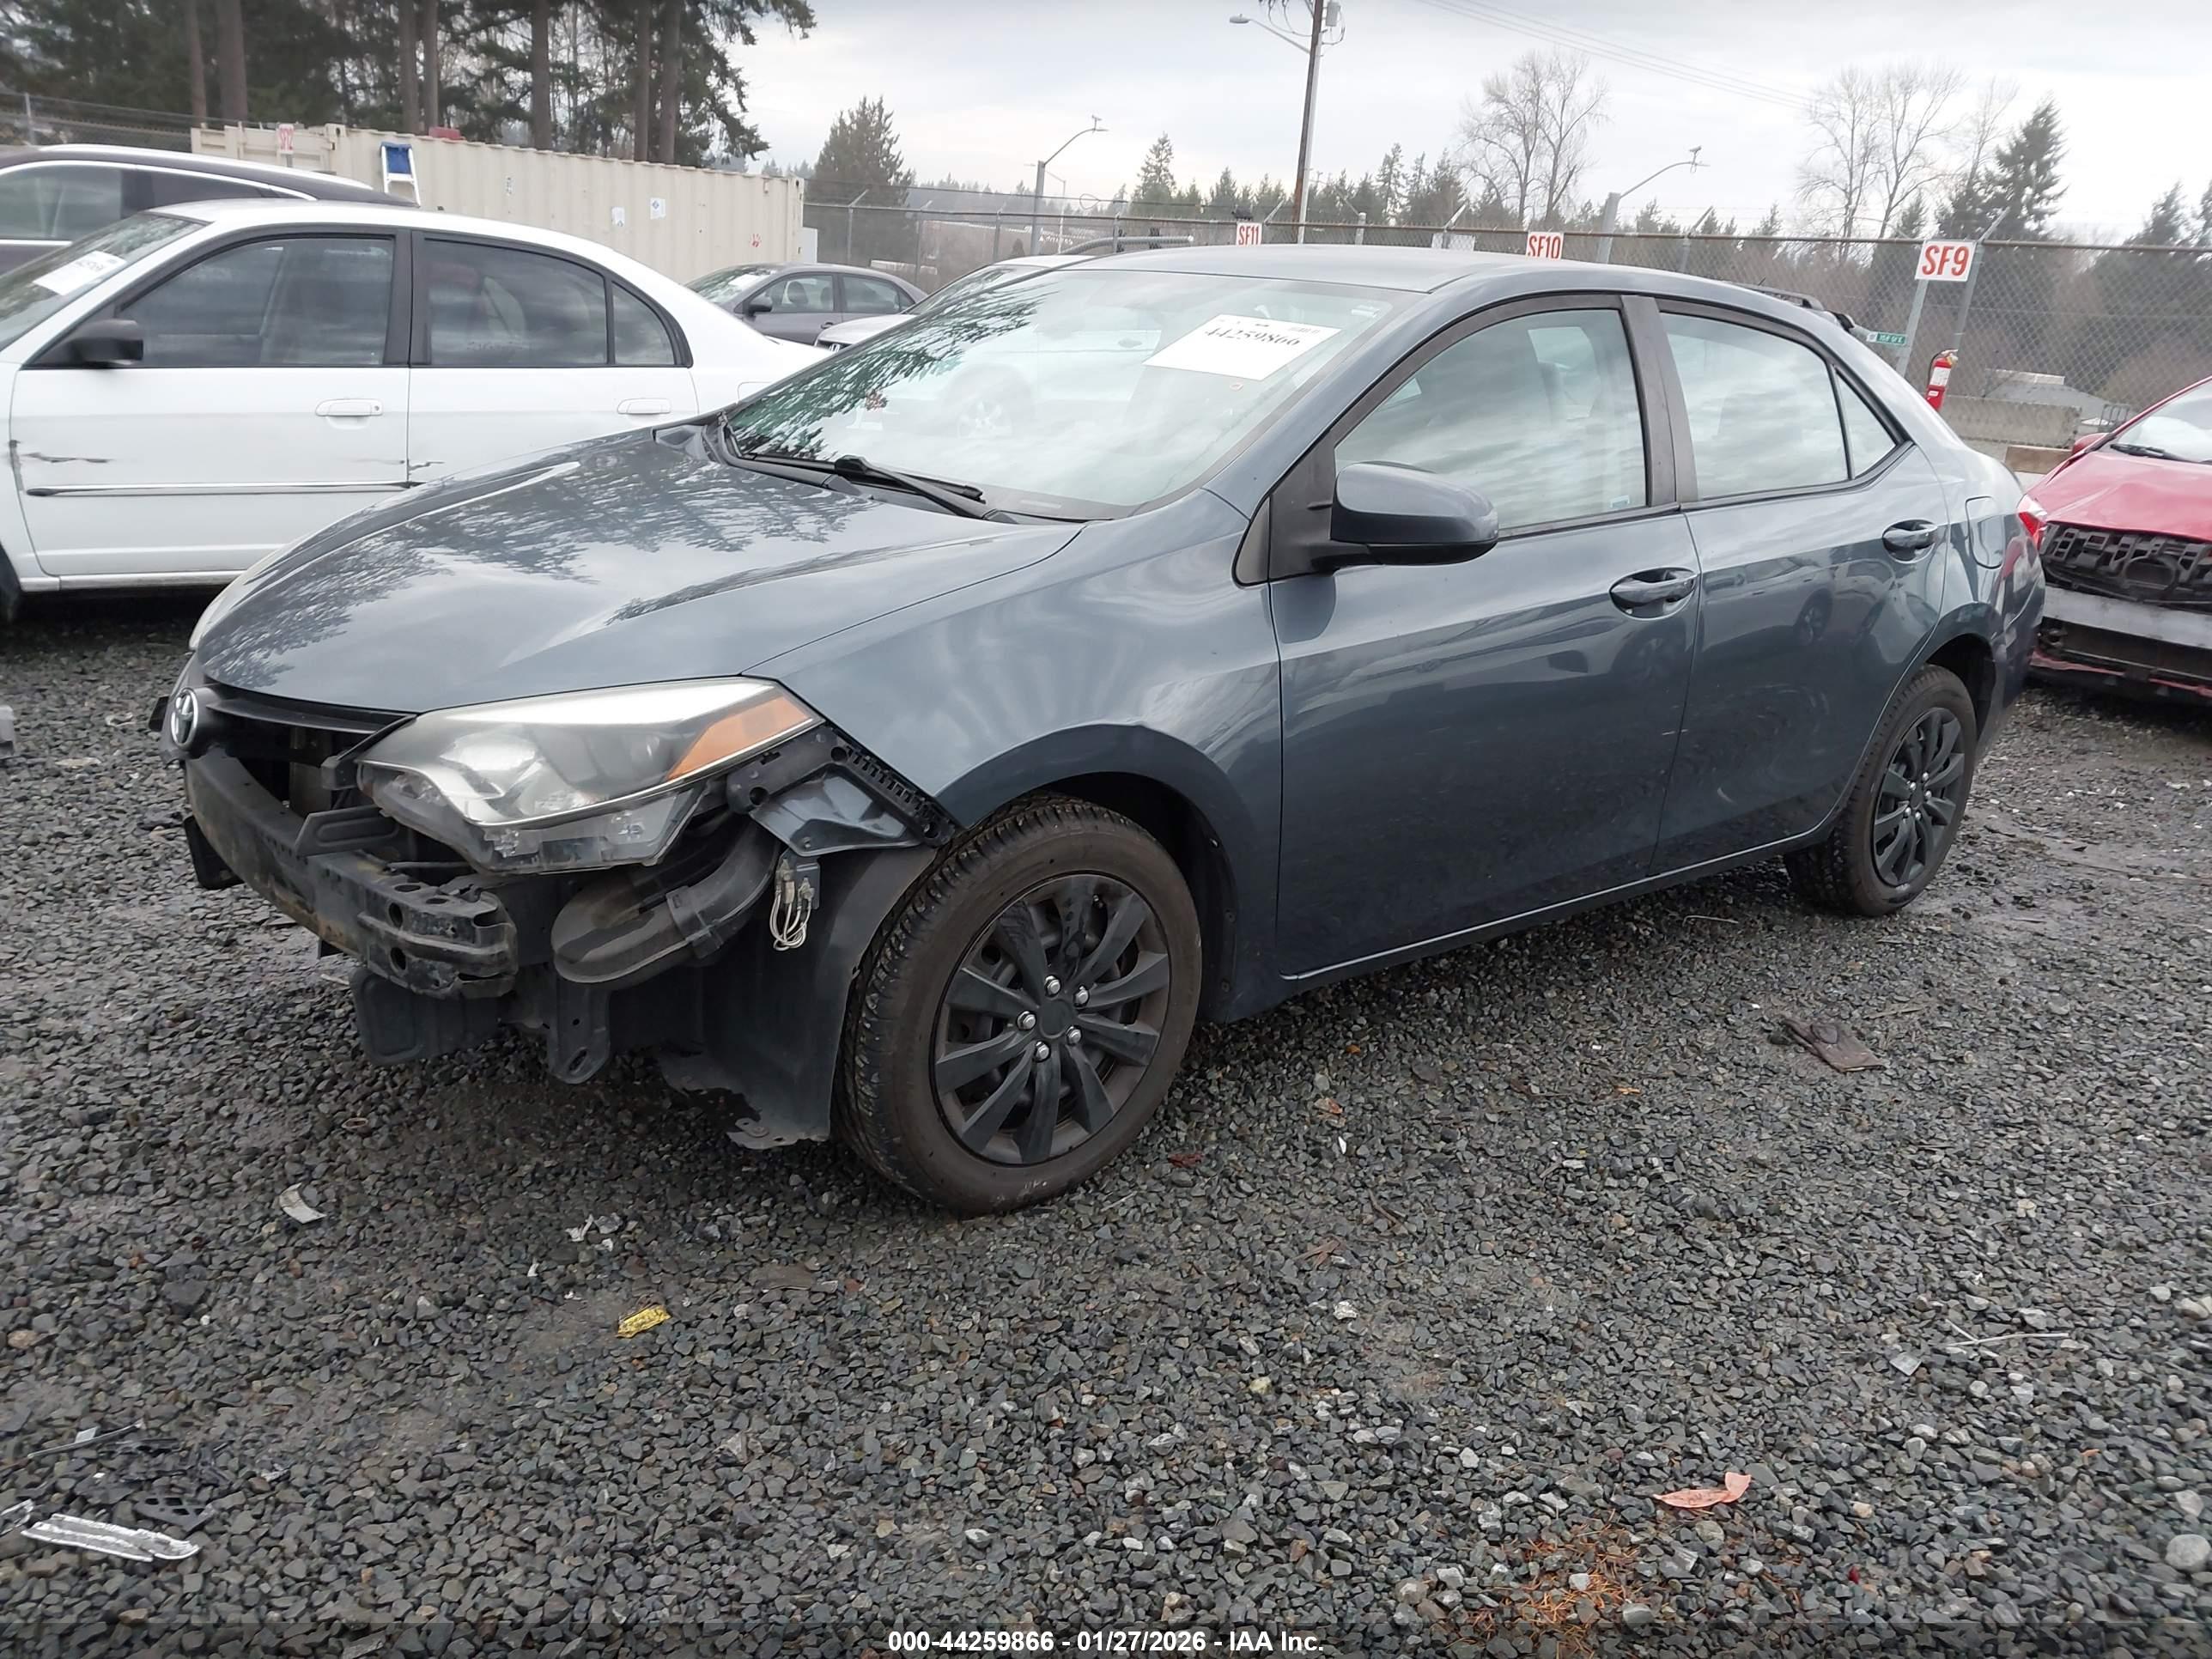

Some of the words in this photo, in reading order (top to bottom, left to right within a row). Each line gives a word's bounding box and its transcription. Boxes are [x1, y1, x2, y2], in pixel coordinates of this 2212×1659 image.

[1237, 225, 1260, 246] SF11
[1528, 234, 1562, 259] SF10
[1921, 244, 1971, 277] SF9
